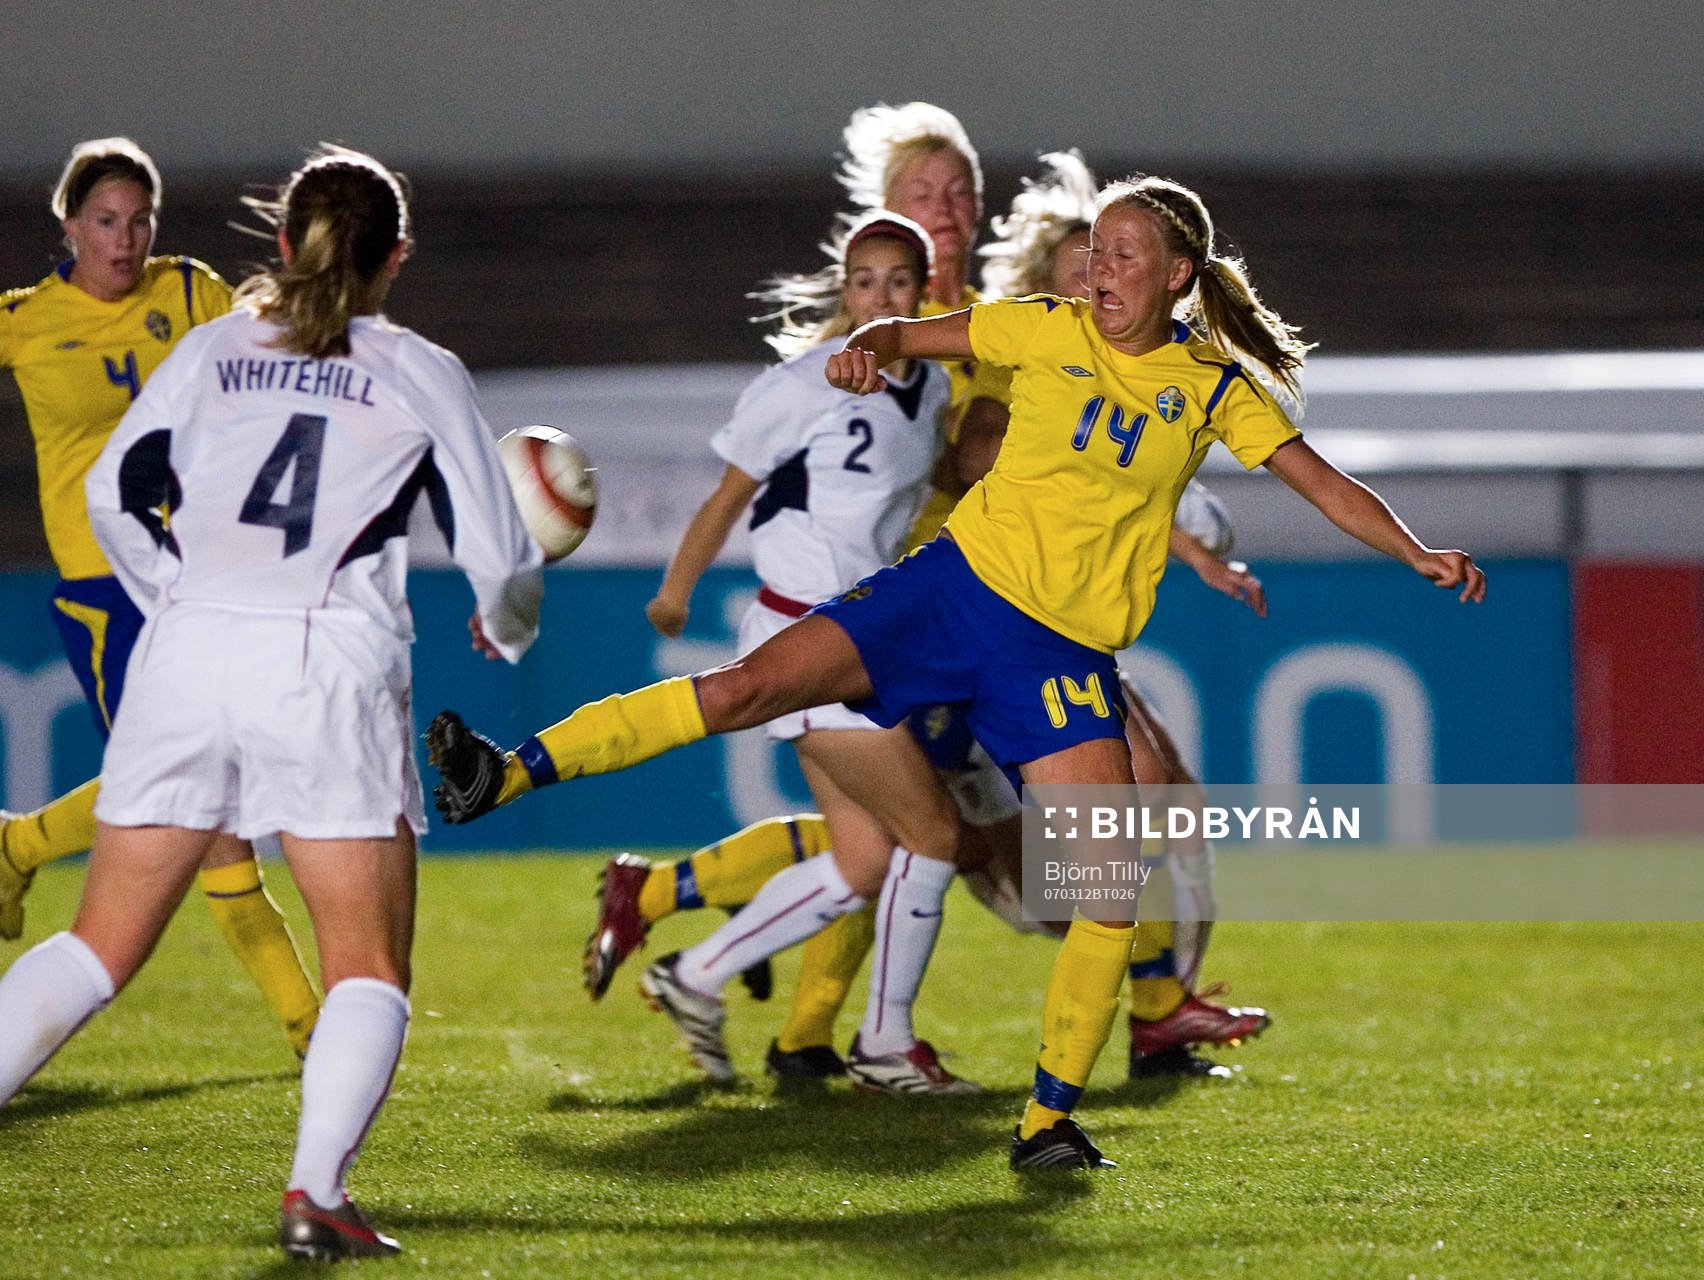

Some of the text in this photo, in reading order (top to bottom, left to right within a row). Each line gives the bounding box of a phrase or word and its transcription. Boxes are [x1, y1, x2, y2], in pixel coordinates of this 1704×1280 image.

[102, 349, 142, 402] 4
[216, 358, 376, 407] WHITEHILL
[842, 417, 874, 474] 2
[1070, 395, 1149, 468] 14
[238, 411, 328, 559] 4
[1040, 672, 1110, 729] 14
